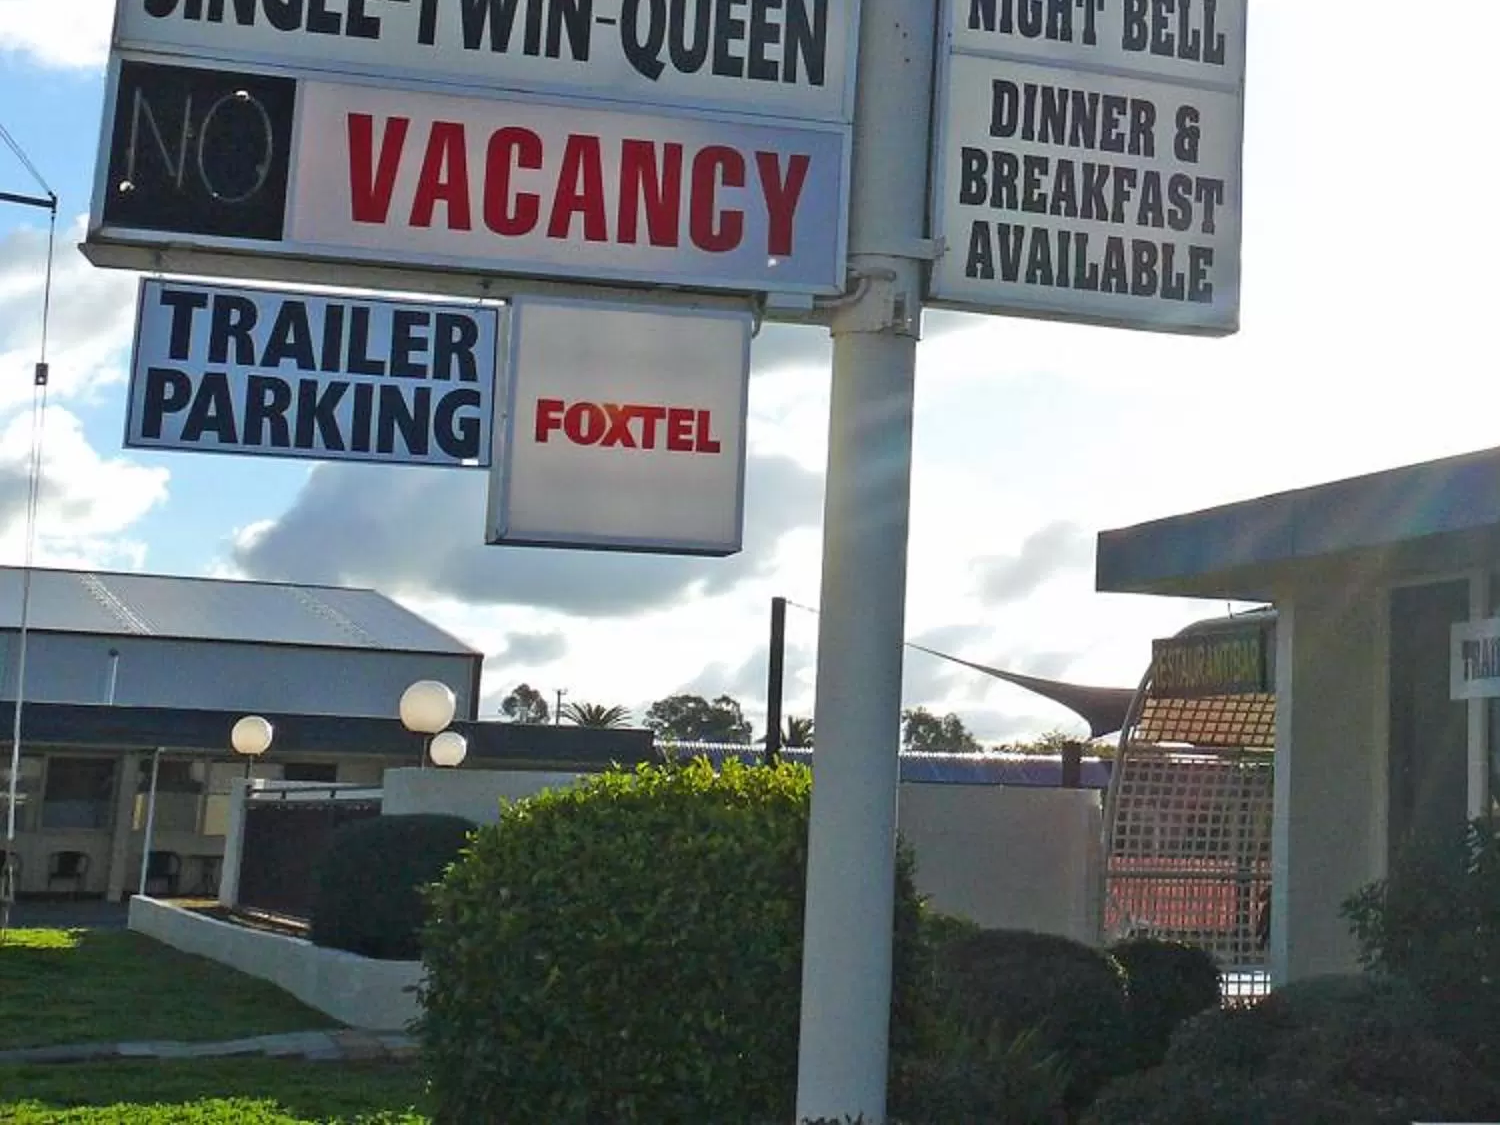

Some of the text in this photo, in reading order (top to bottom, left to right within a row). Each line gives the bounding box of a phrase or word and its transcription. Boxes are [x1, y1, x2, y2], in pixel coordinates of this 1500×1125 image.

[990, 79, 1200, 163] DINNER &
[127, 86, 811, 257] NO VACANCY
[959, 147, 1224, 235] BREAKFAST
[965, 220, 1214, 303] AVAILABLE
[160, 289, 478, 382] TRAILER
[141, 367, 481, 459] PARKING
[535, 399, 721, 453] FOXTEL
